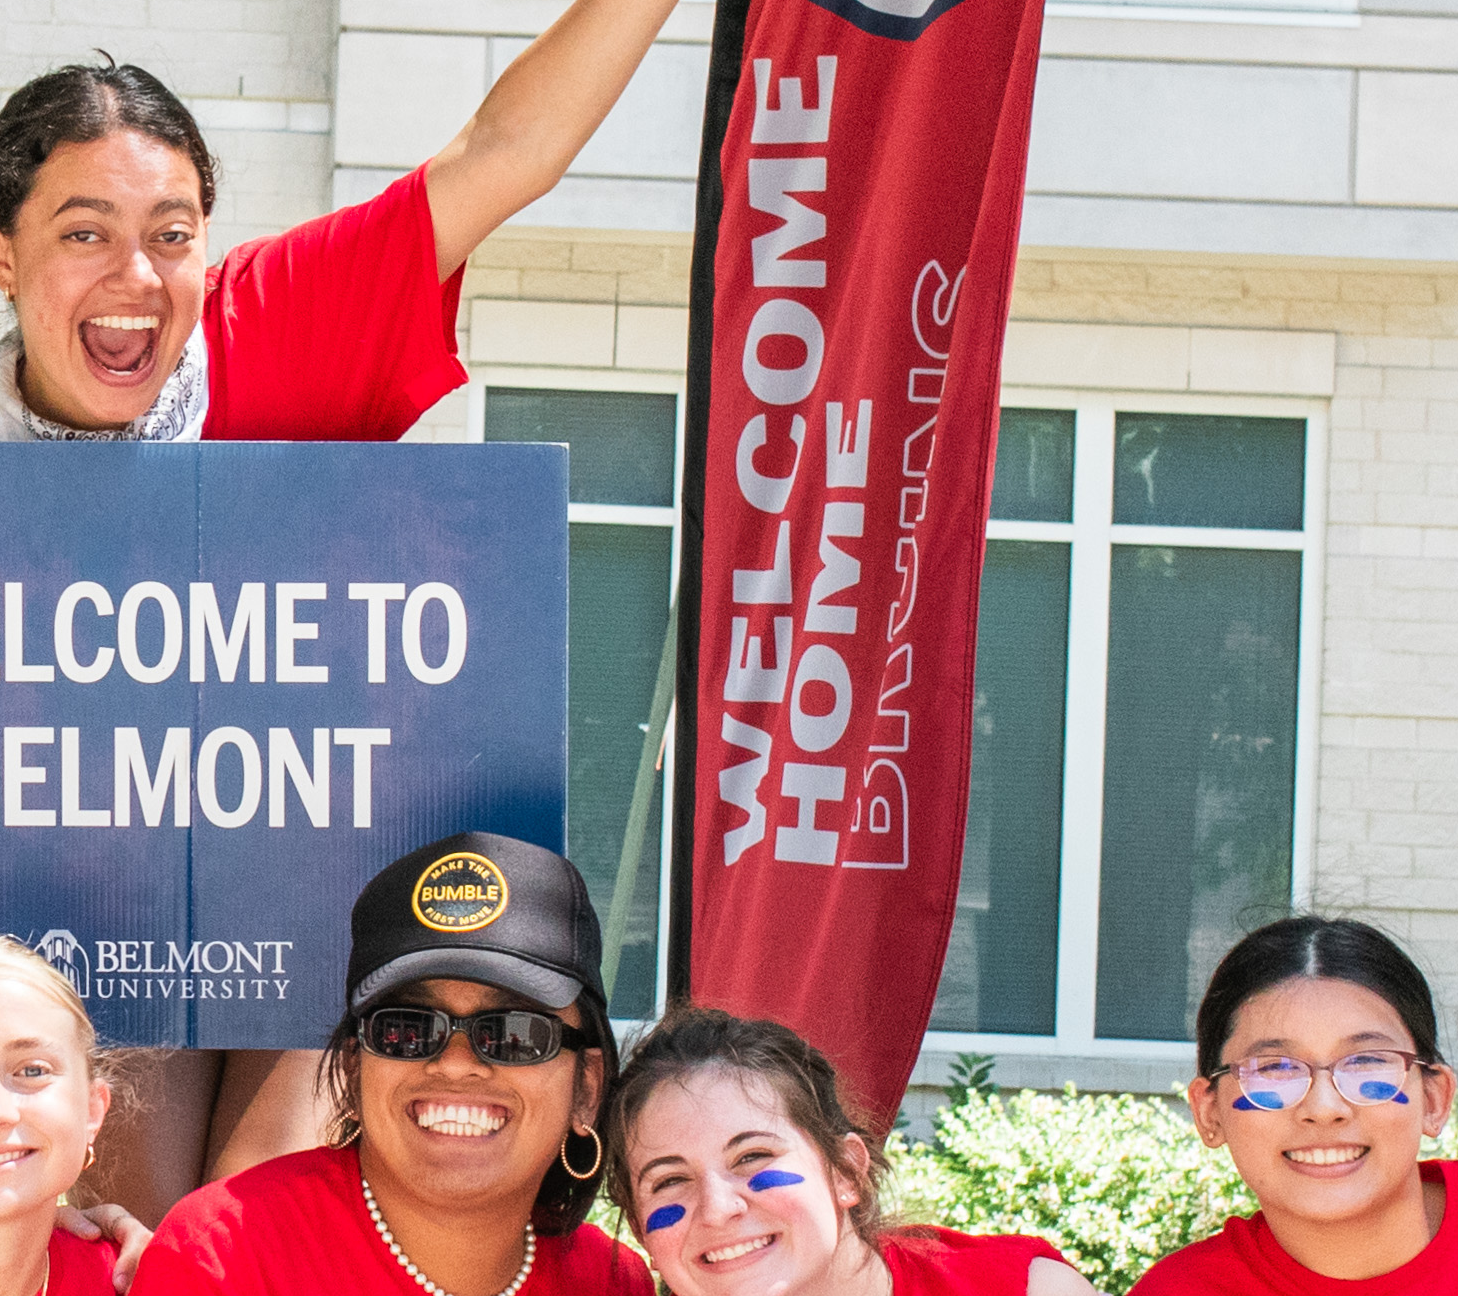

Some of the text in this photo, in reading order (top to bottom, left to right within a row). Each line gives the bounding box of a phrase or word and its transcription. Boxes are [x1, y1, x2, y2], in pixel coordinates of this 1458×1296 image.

[721, 54, 838, 867] WELCOME
[348, 581, 468, 685] TO
[774, 398, 872, 867] HOME
[431, 860, 491, 880] MAKE THE
[421, 884, 499, 902] BUMBLE
[425, 905, 493, 925] FIRST MOVE
[95, 940, 293, 974] BELMONT
[96, 980, 291, 1001] UNIVERSITY
